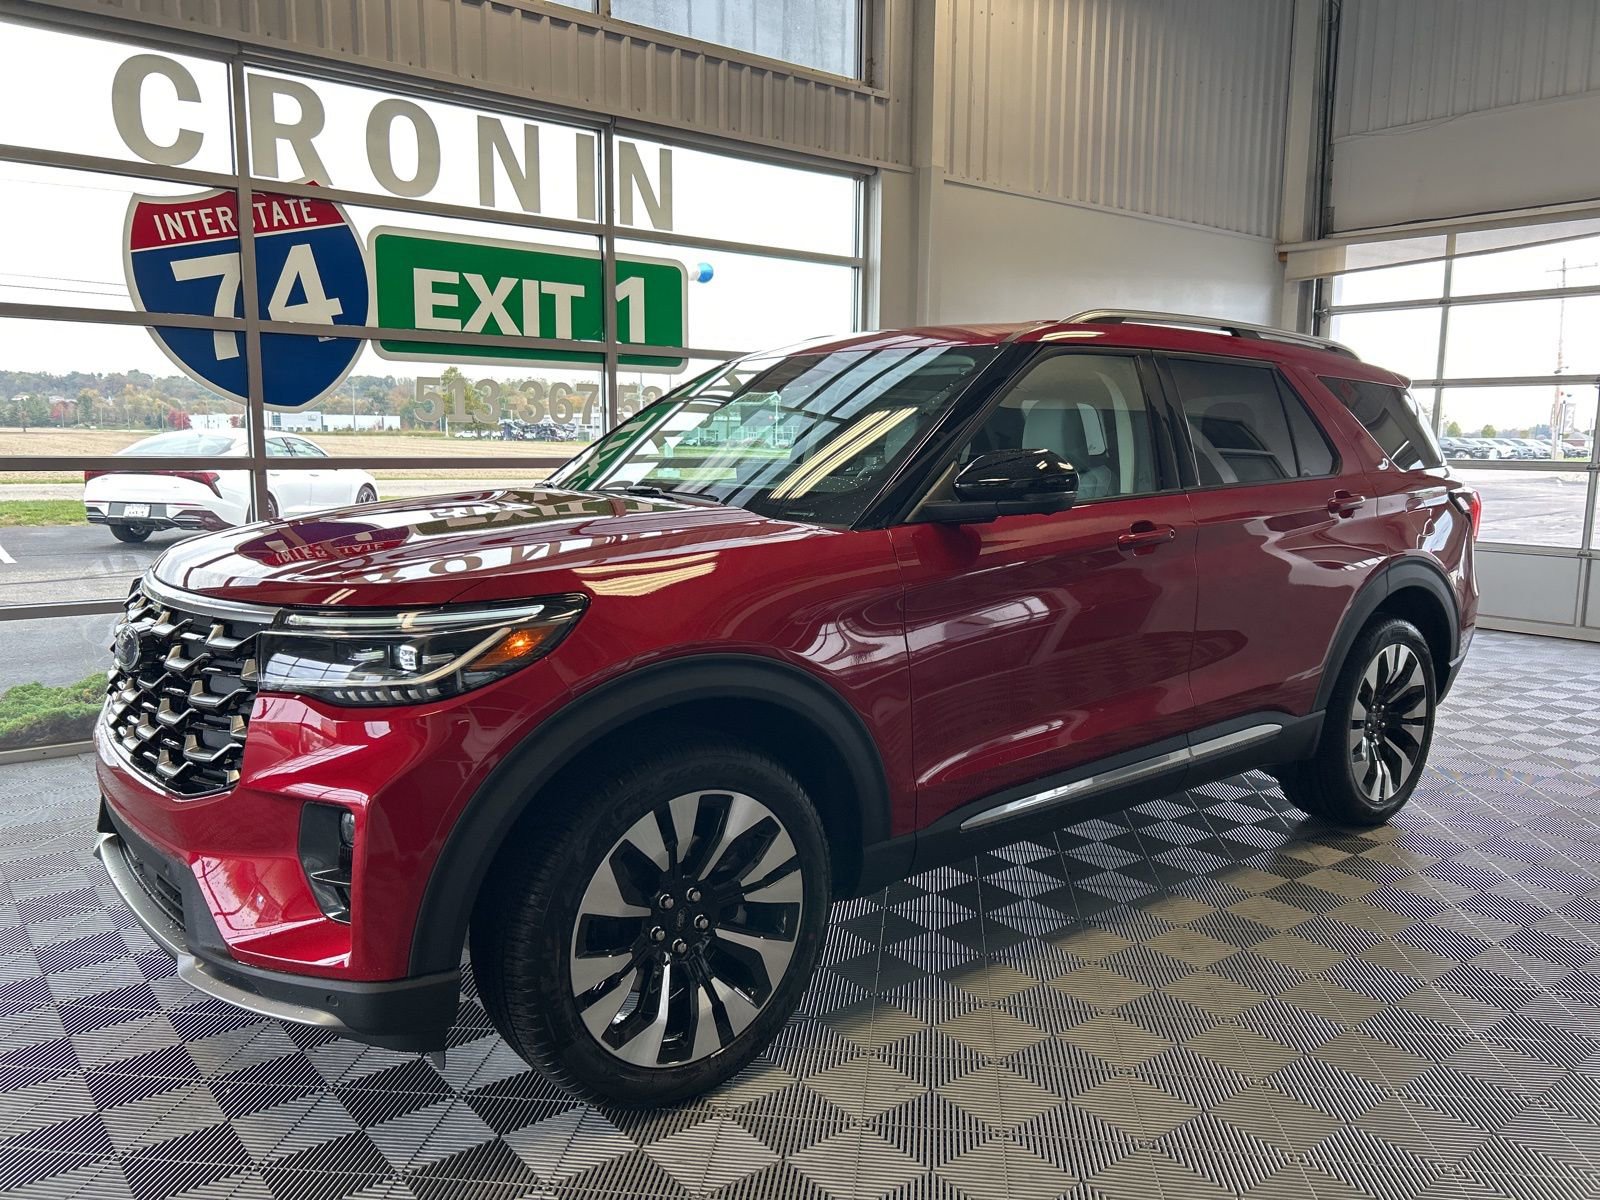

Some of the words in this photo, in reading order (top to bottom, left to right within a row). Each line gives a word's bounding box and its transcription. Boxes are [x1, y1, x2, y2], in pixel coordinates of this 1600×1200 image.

[111, 53, 673, 231] CRONIN
[153, 198, 318, 241] INTERTATE
[170, 243, 344, 361] 74
[413, 267, 586, 340] EXIT
[614, 276, 646, 344] 1
